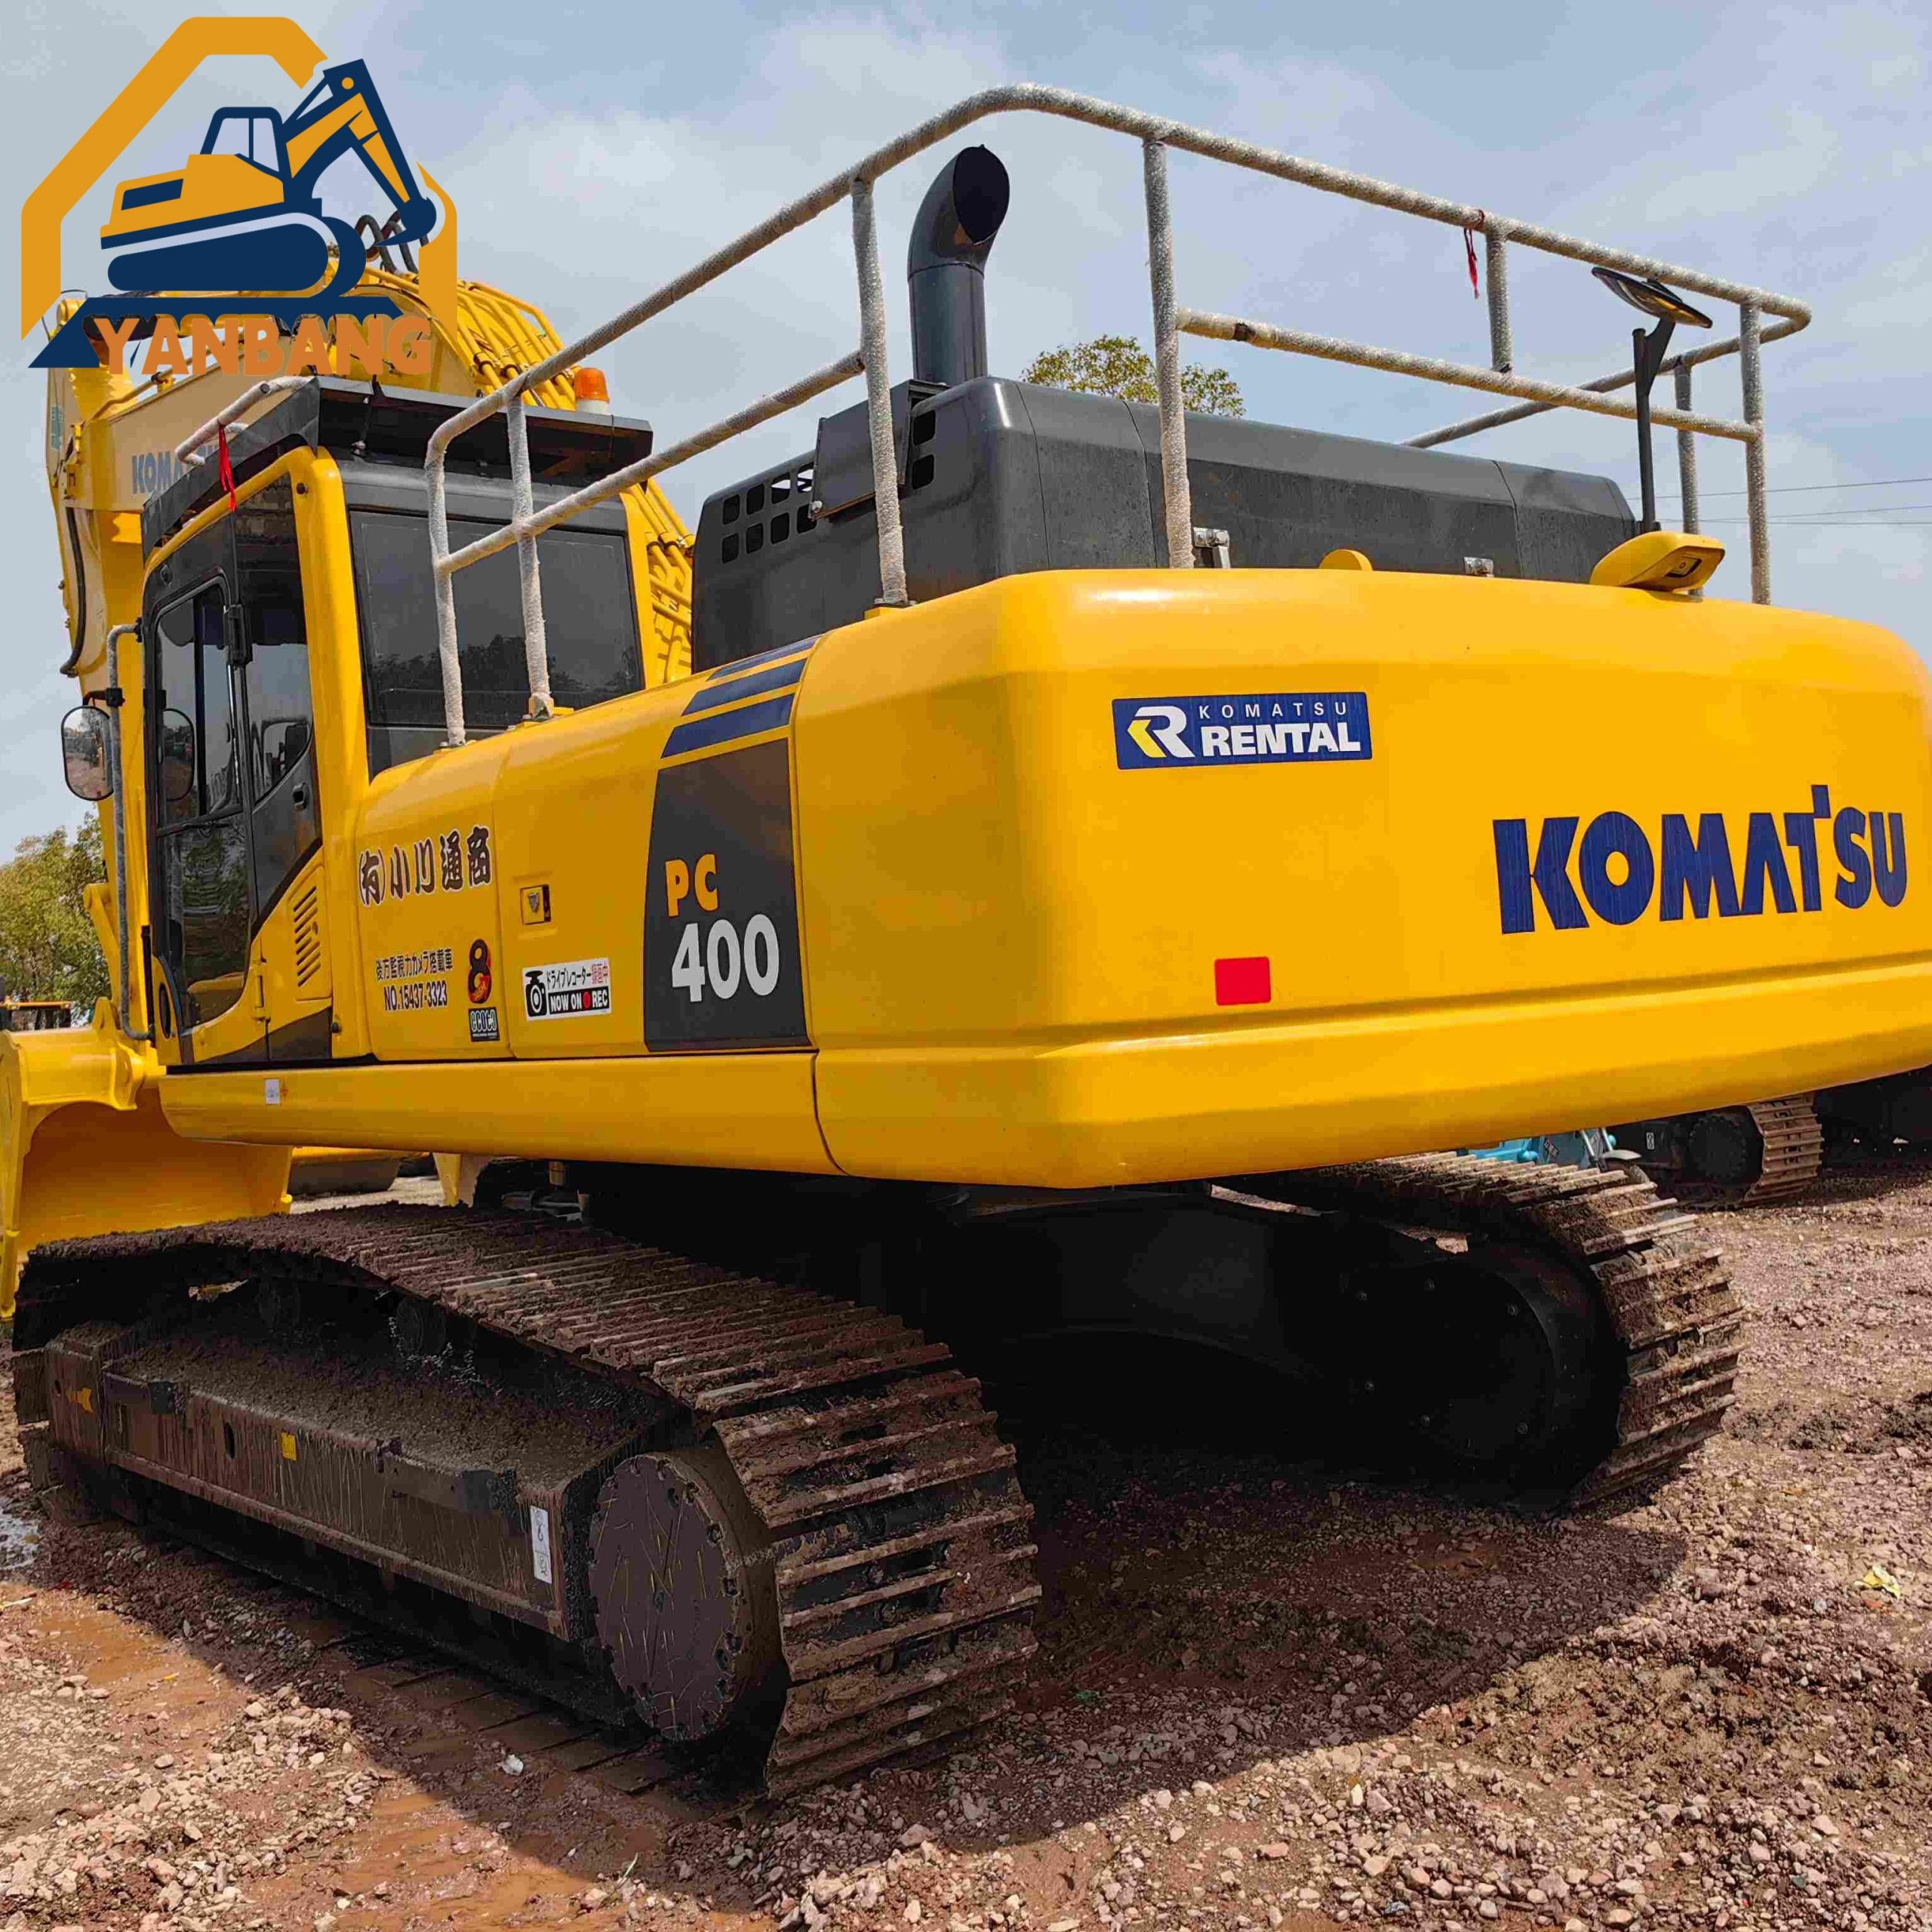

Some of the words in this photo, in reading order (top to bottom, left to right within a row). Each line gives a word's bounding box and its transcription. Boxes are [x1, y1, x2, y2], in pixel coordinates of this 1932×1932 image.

[1198, 702, 1347, 720] KOMATSU
[1201, 722, 1361, 757] RENTAL
[665, 854, 718, 917] PC
[1492, 785, 1907, 934] KOMATSU
[468, 938, 492, 1004] 8
[672, 913, 780, 1002] 400
[550, 994, 569, 1012] NOW
[571, 992, 583, 1010] ON
[592, 989, 608, 1008] REC
